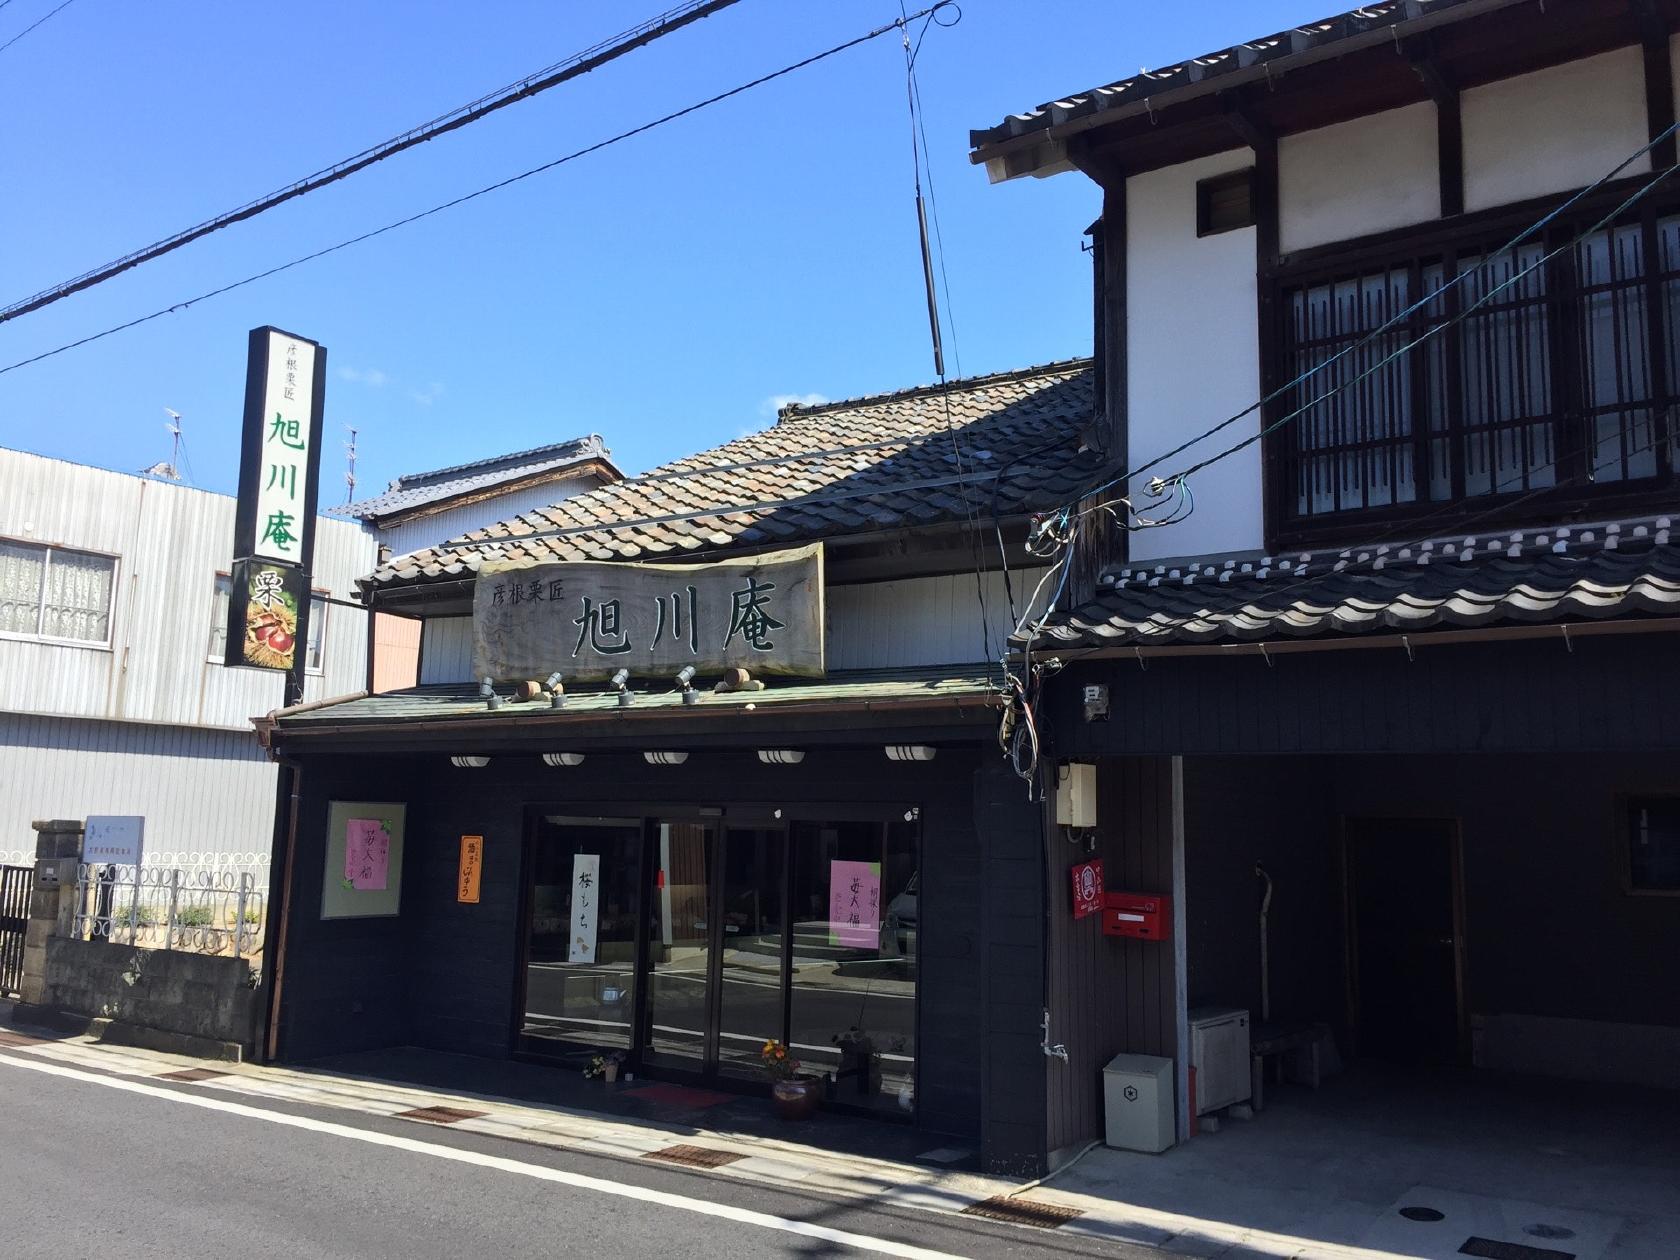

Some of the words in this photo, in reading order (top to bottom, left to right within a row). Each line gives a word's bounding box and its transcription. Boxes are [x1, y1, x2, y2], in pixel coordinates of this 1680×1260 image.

[260, 411, 305, 552] 旭川庵
[252, 571, 285, 610] 栗
[572, 577, 786, 658] 旭川庵
